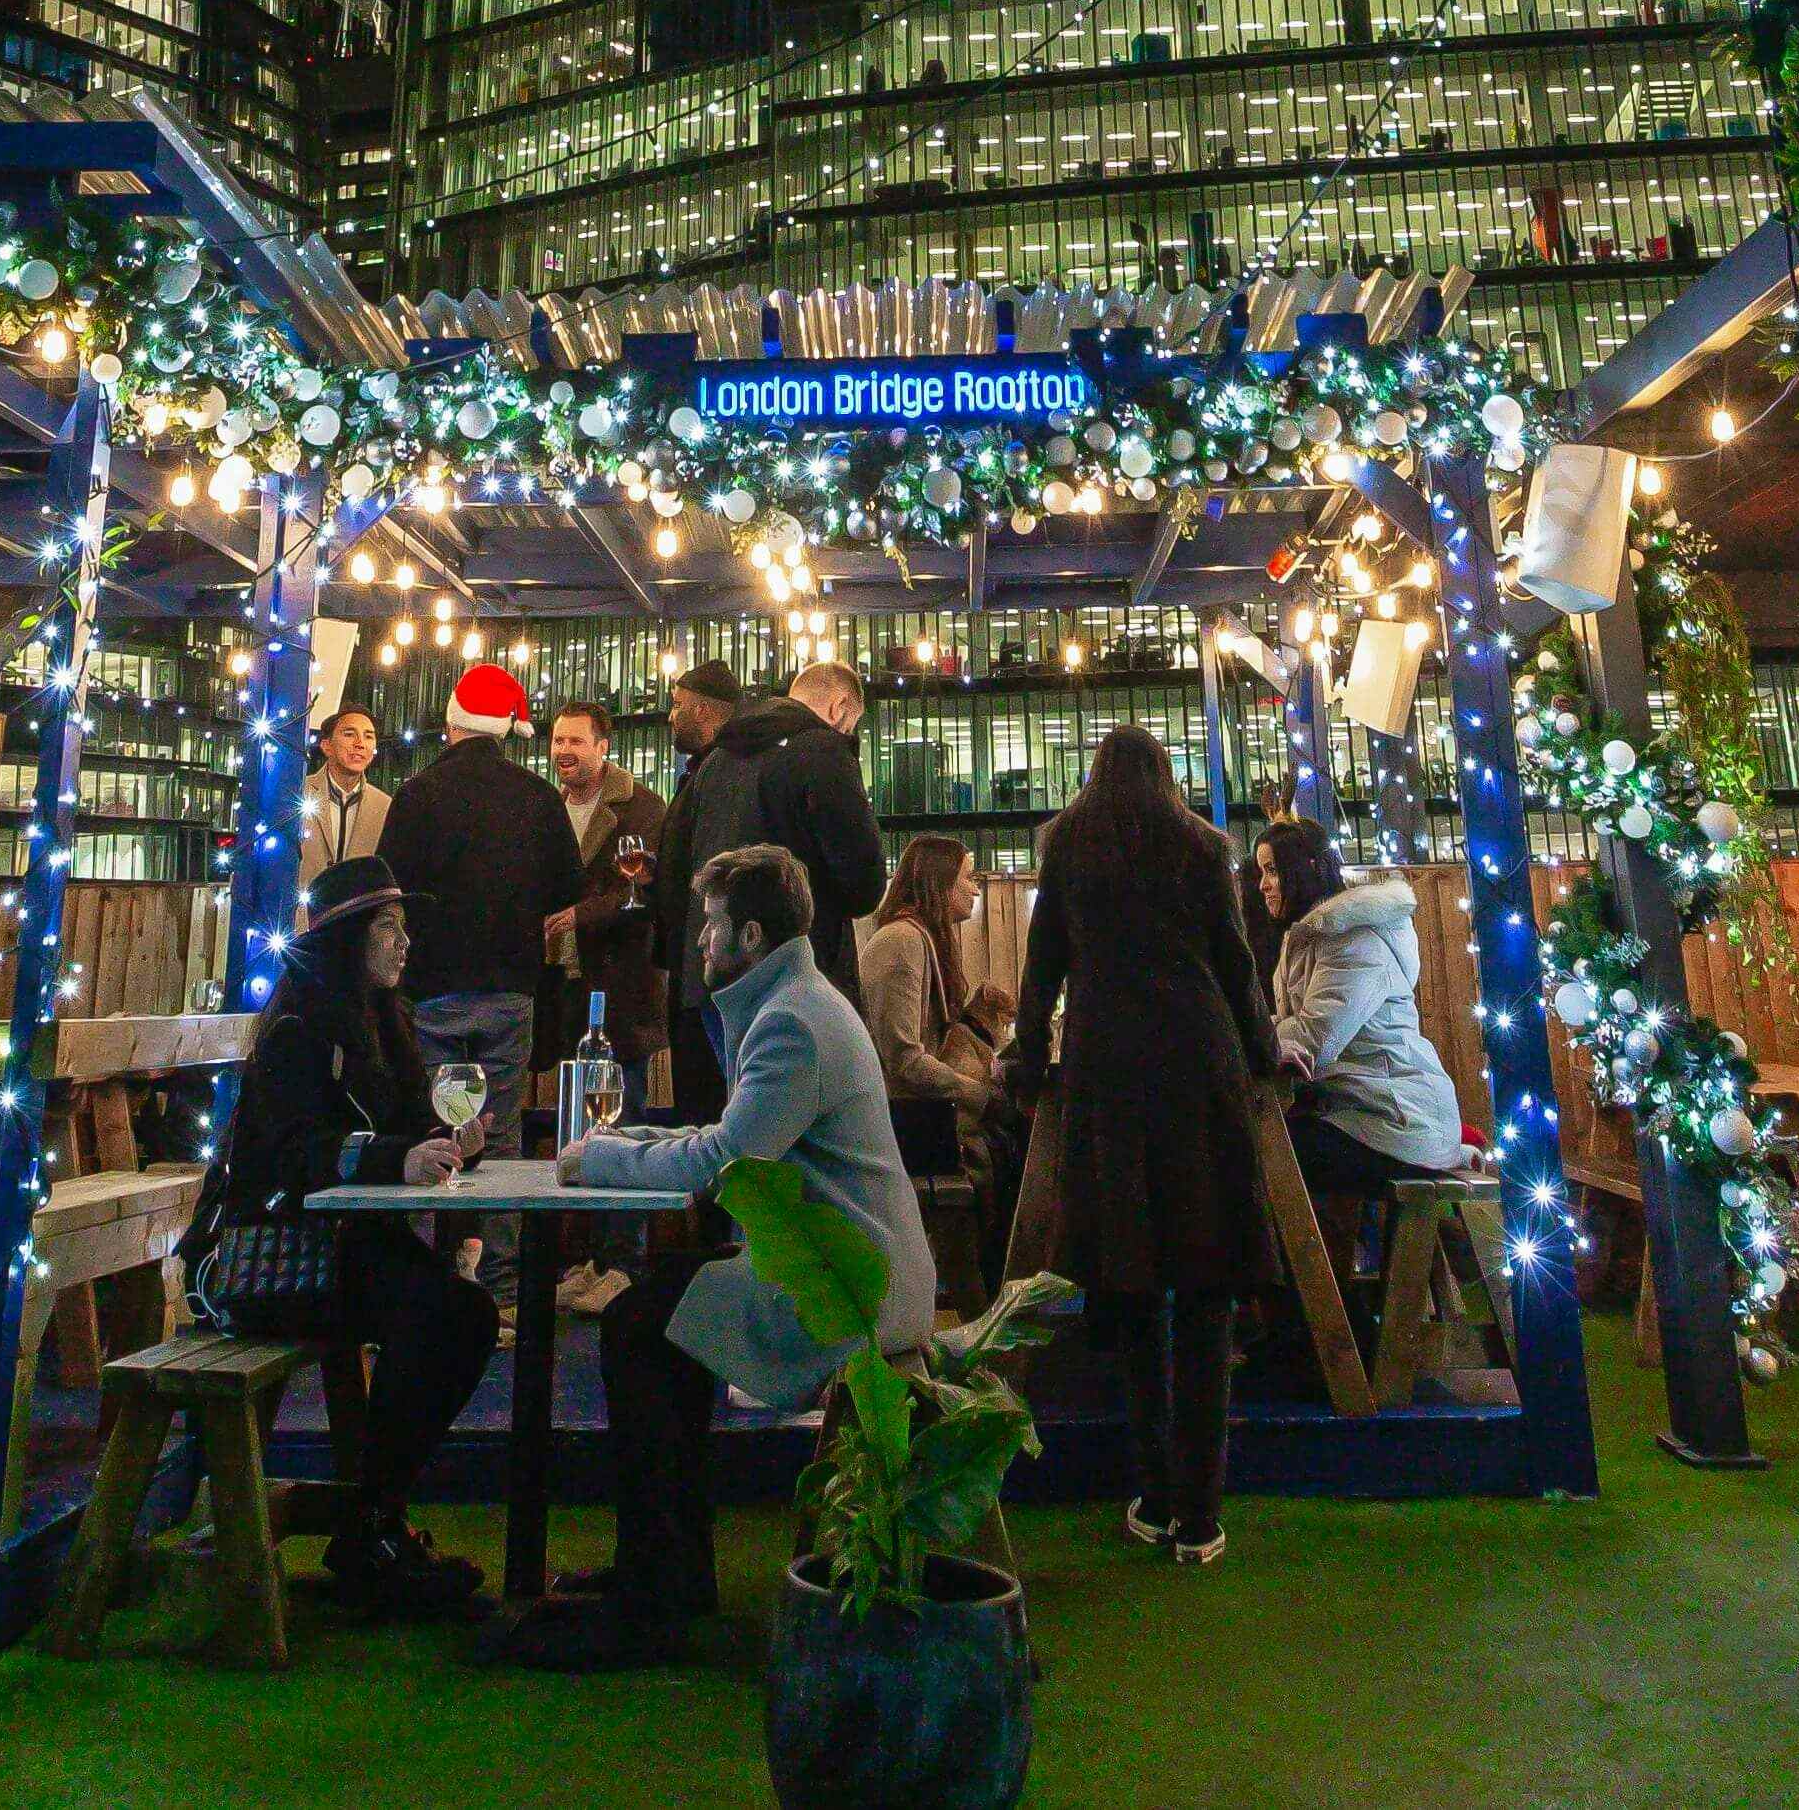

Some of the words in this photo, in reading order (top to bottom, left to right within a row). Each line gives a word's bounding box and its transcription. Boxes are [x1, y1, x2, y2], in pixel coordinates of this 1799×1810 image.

[700, 375, 824, 417] London
[834, 370, 944, 418] Bridge
[955, 368, 1086, 413] Rooftop
